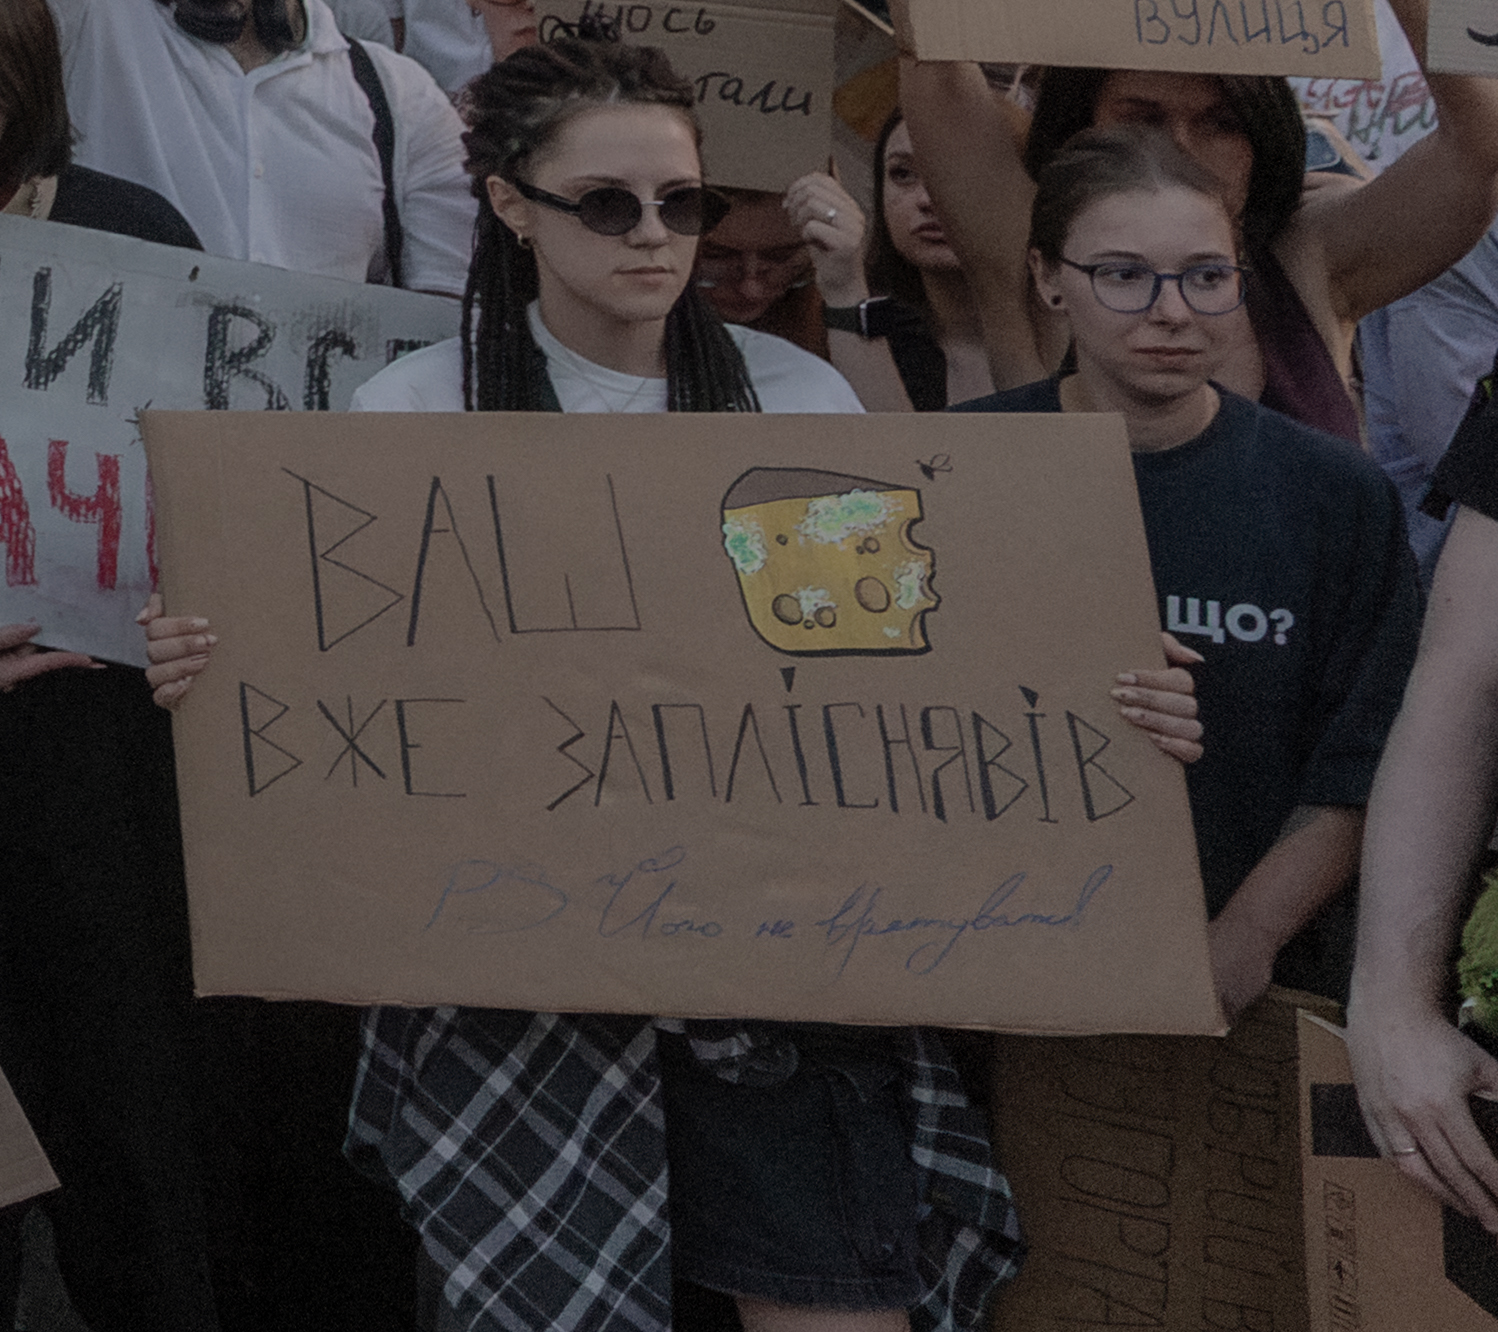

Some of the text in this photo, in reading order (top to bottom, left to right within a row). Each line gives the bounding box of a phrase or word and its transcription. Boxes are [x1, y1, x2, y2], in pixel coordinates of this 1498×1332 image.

[281, 466, 642, 653] ВАШ
[1165, 594, 1300, 646] ЩО?
[239, 664, 1137, 826] ВЖЕ ЗАПЛІСНЯВІВ
